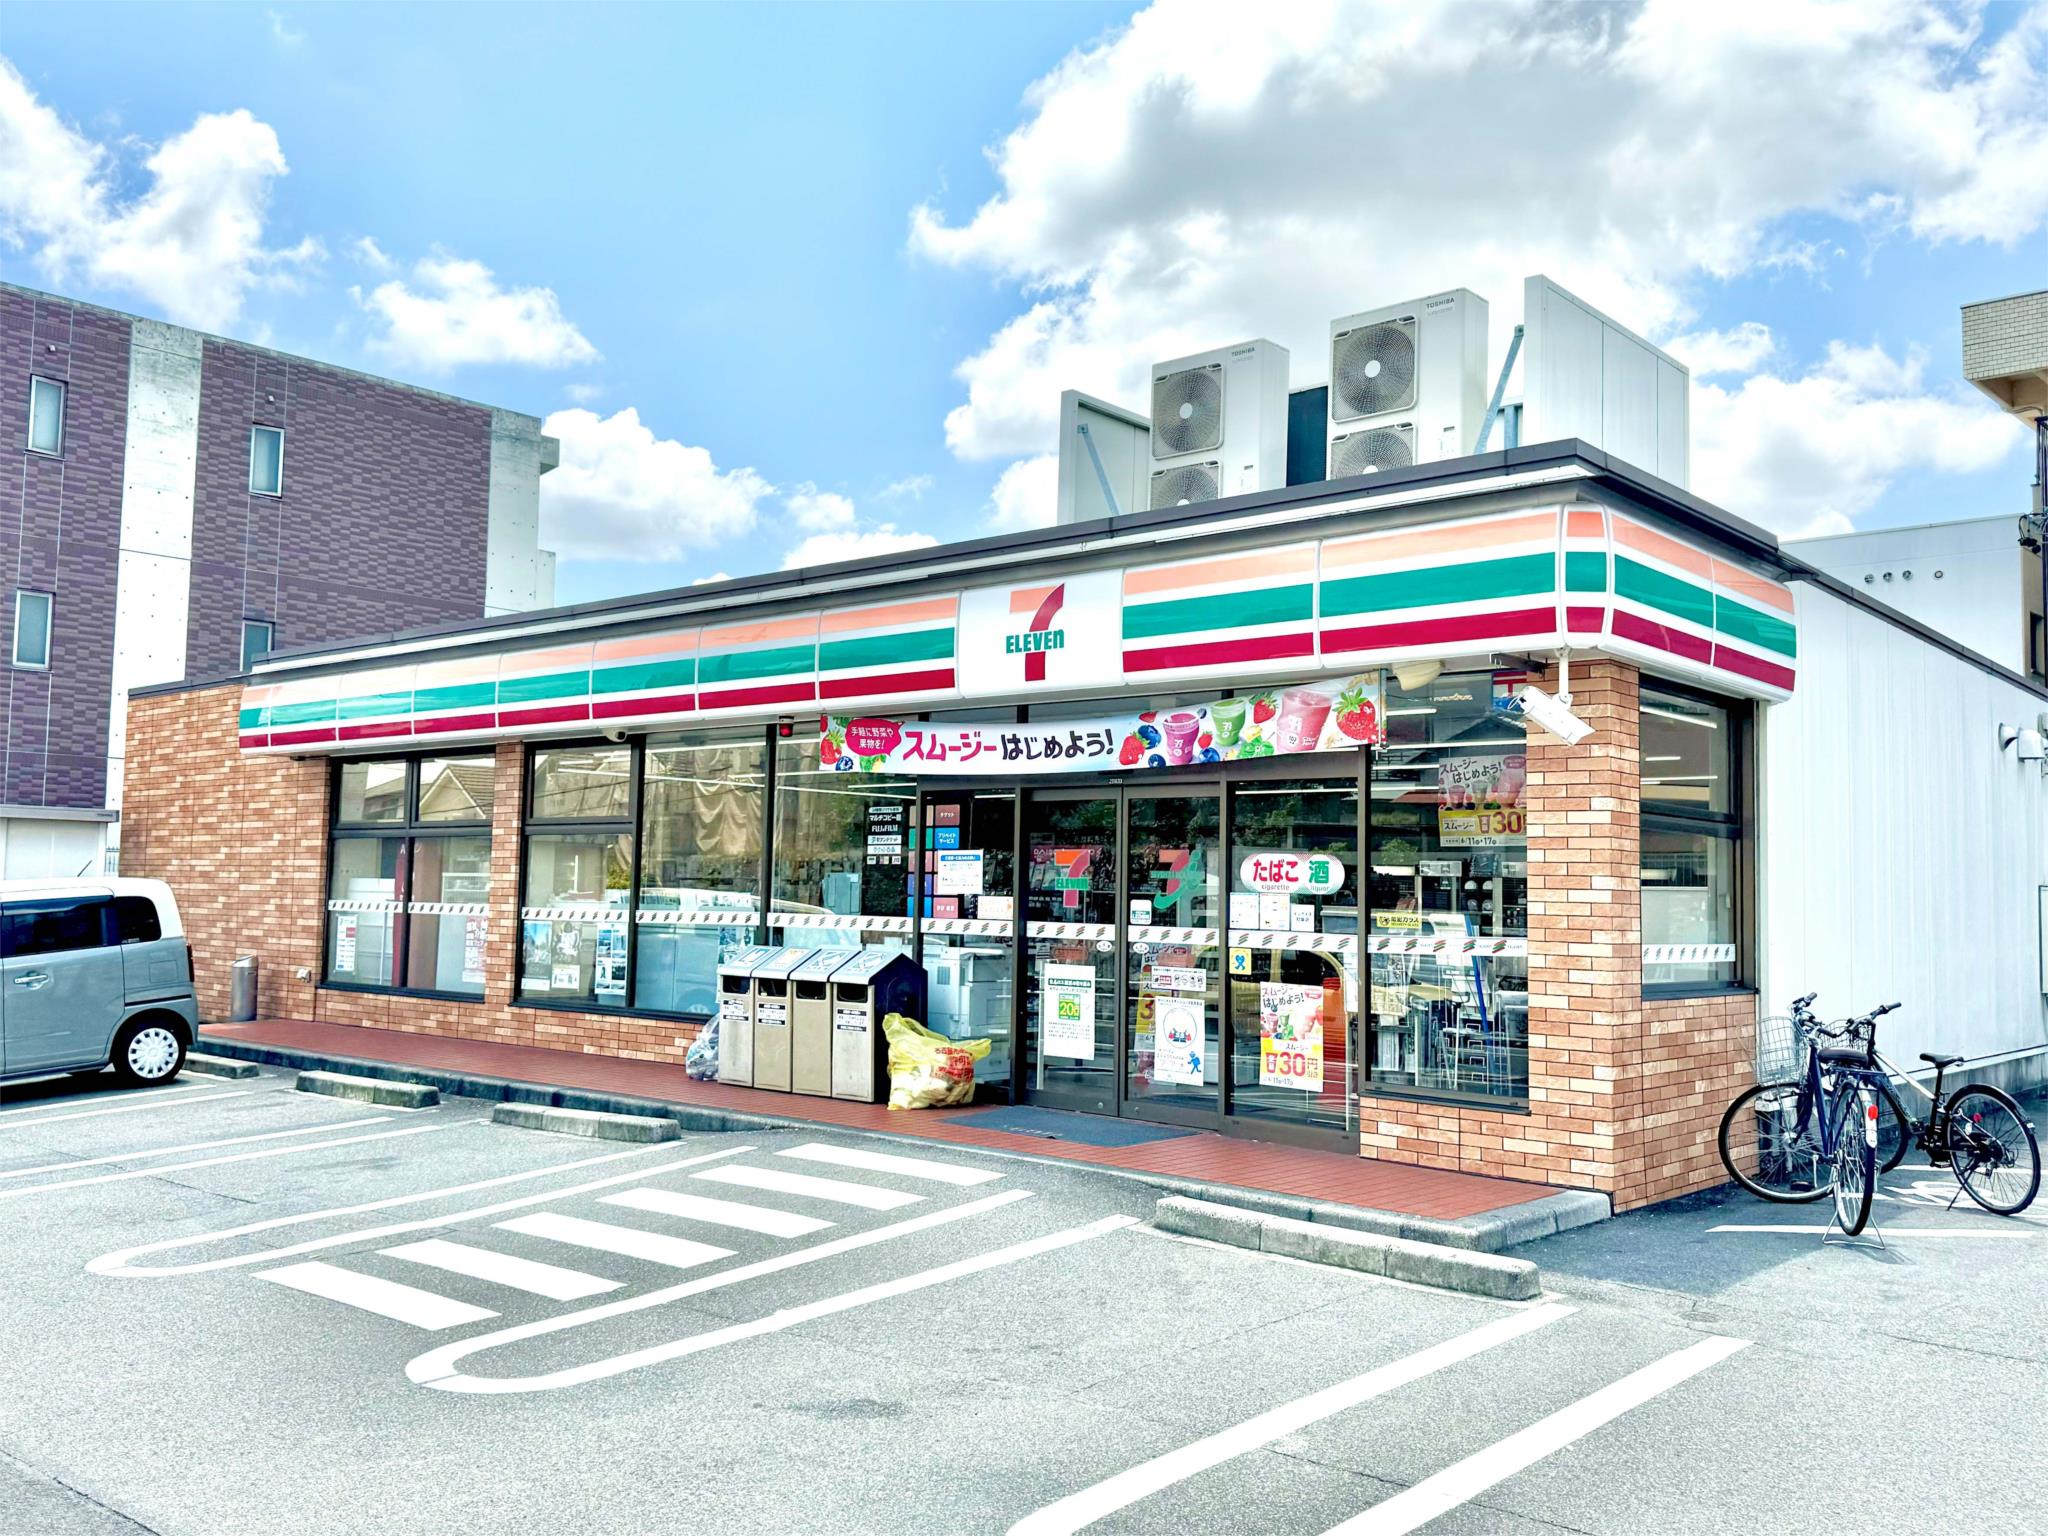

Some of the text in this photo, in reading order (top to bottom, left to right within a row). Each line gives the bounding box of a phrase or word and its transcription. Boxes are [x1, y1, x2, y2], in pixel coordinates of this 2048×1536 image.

[1426, 298, 1455, 309] TOSHIBA
[1231, 347, 1256, 357] TOSHIBA
[851, 726, 894, 738] 手軽に野菜や
[1440, 758, 1478, 775] スムージー
[1443, 822, 1475, 830] スムージー
[1253, 858, 1330, 884] たばこ 酒
